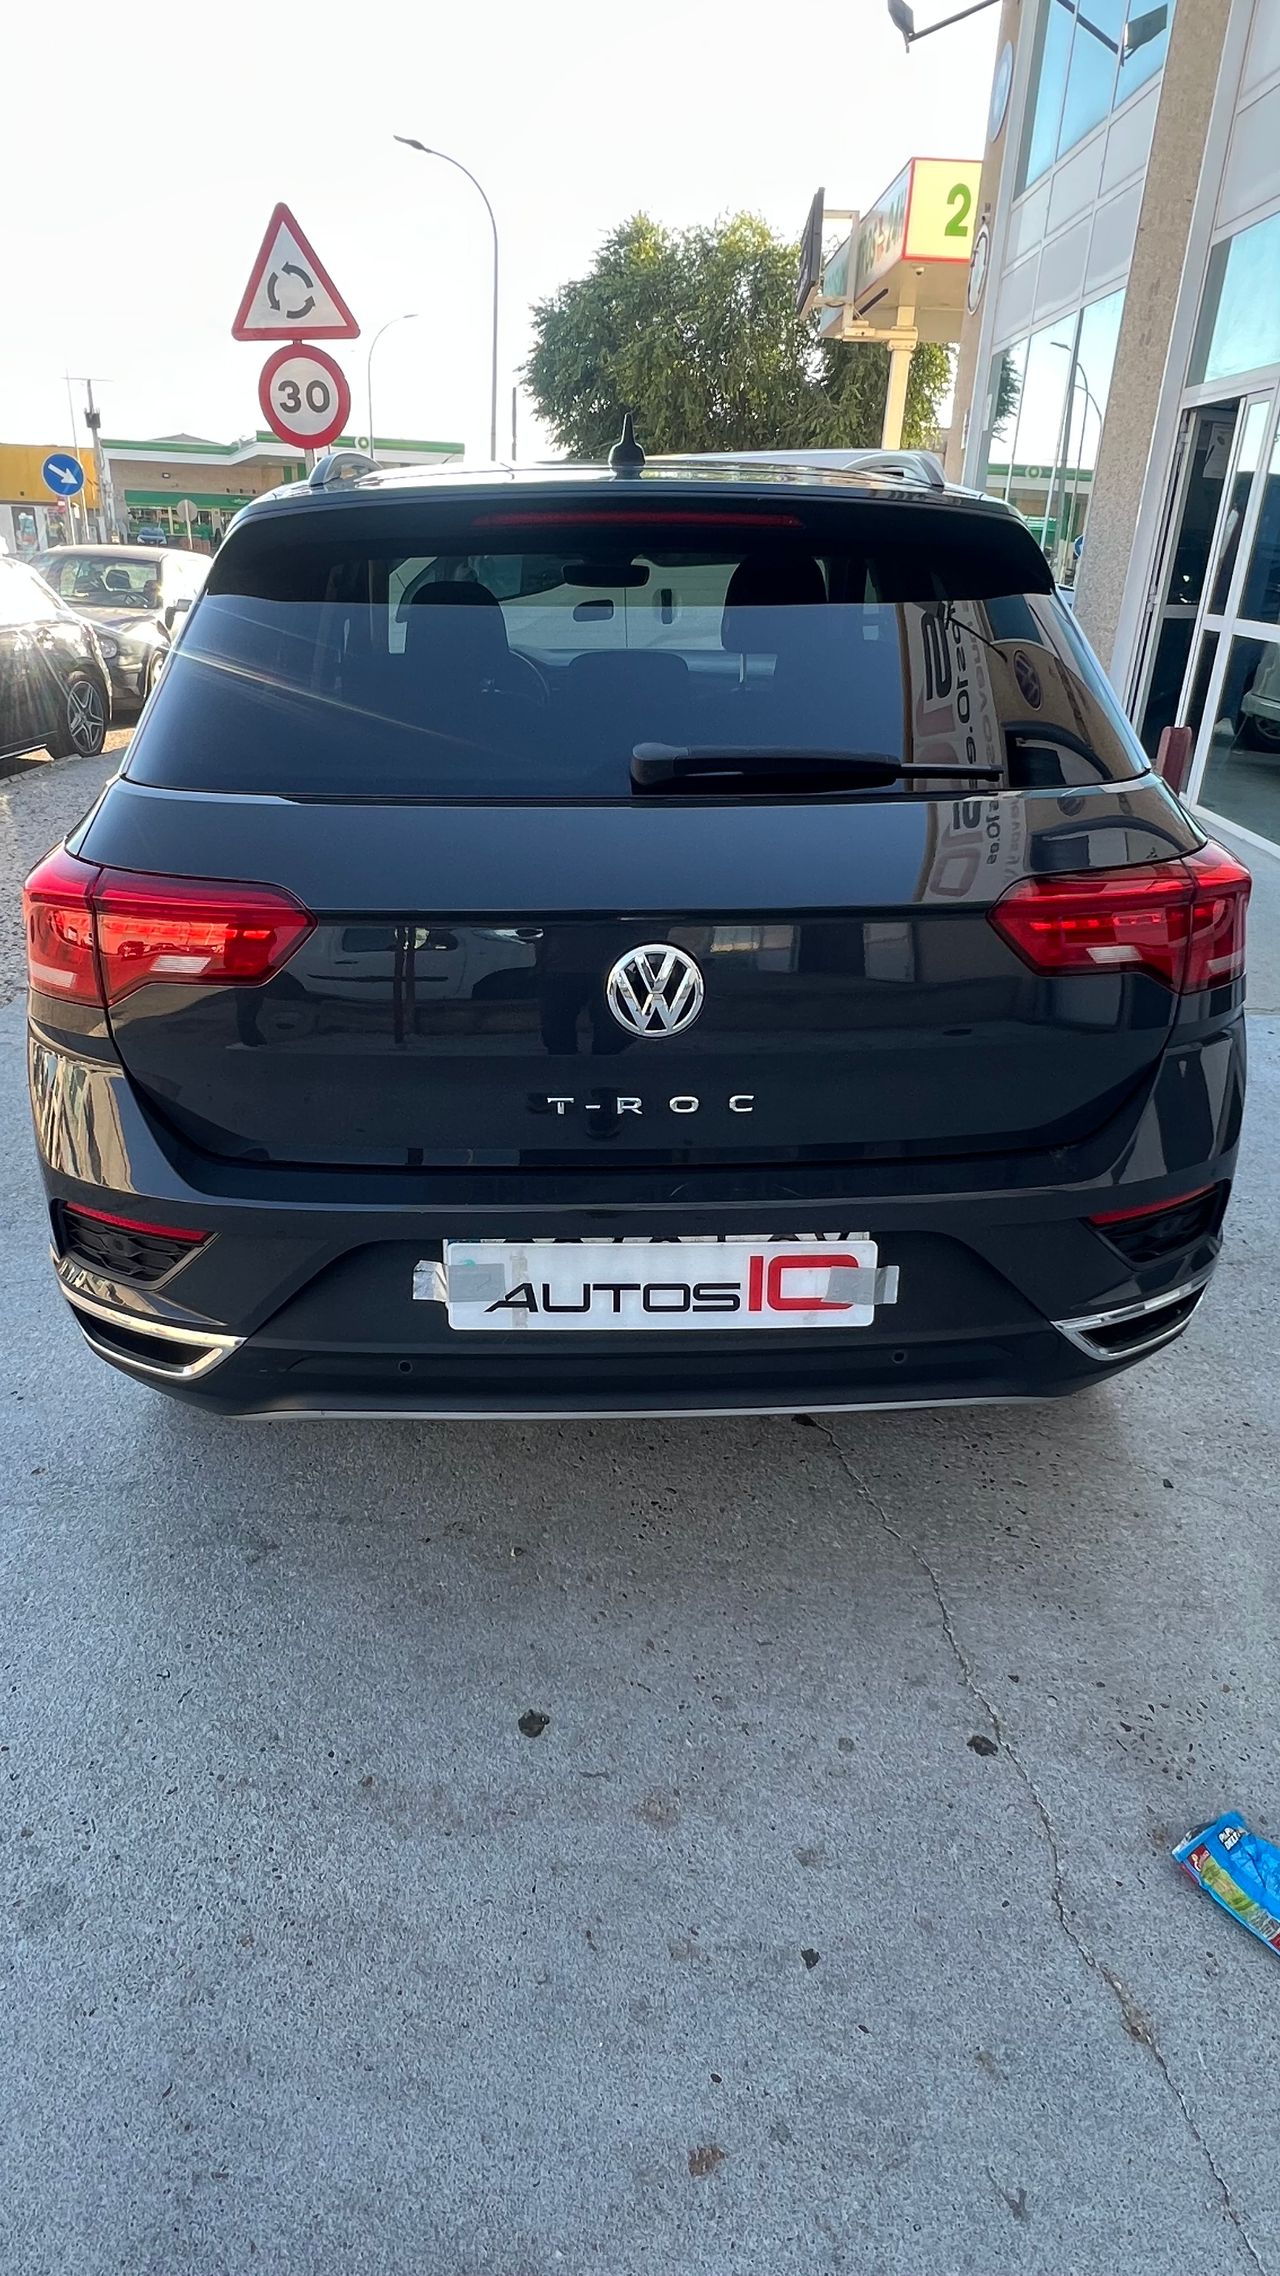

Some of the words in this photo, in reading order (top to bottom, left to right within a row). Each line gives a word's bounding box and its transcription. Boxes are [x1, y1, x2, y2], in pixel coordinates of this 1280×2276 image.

[944, 182, 972, 237] 2
[278, 379, 332, 414] 30
[547, 1094, 755, 1115] T-ROC
